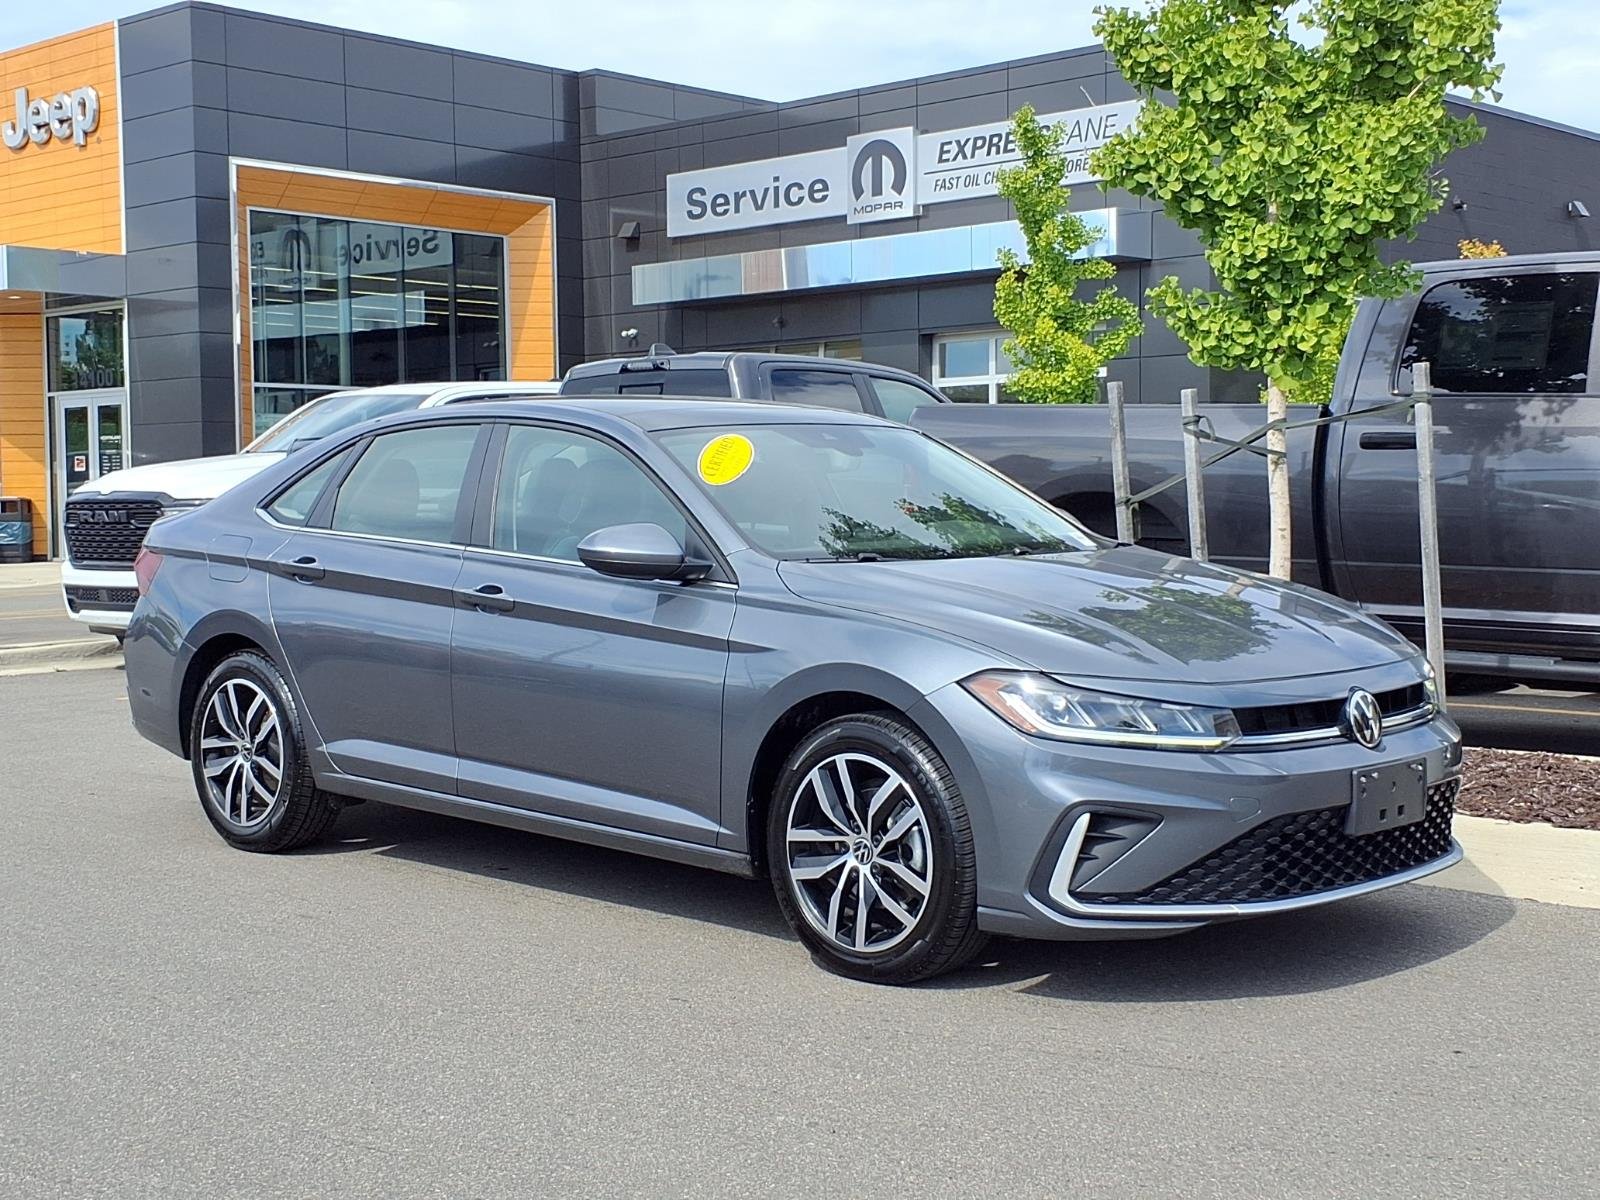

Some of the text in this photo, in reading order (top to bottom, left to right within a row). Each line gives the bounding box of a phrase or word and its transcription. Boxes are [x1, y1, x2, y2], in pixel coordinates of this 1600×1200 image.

[2, 84, 99, 149] Jeep
[937, 113, 1118, 164] EXPRE ANE
[685, 176, 830, 221] Service
[934, 175, 961, 192] FAST
[963, 173, 981, 188] OIL
[853, 200, 904, 216] MOPAR
[78, 510, 128, 523] RAM
